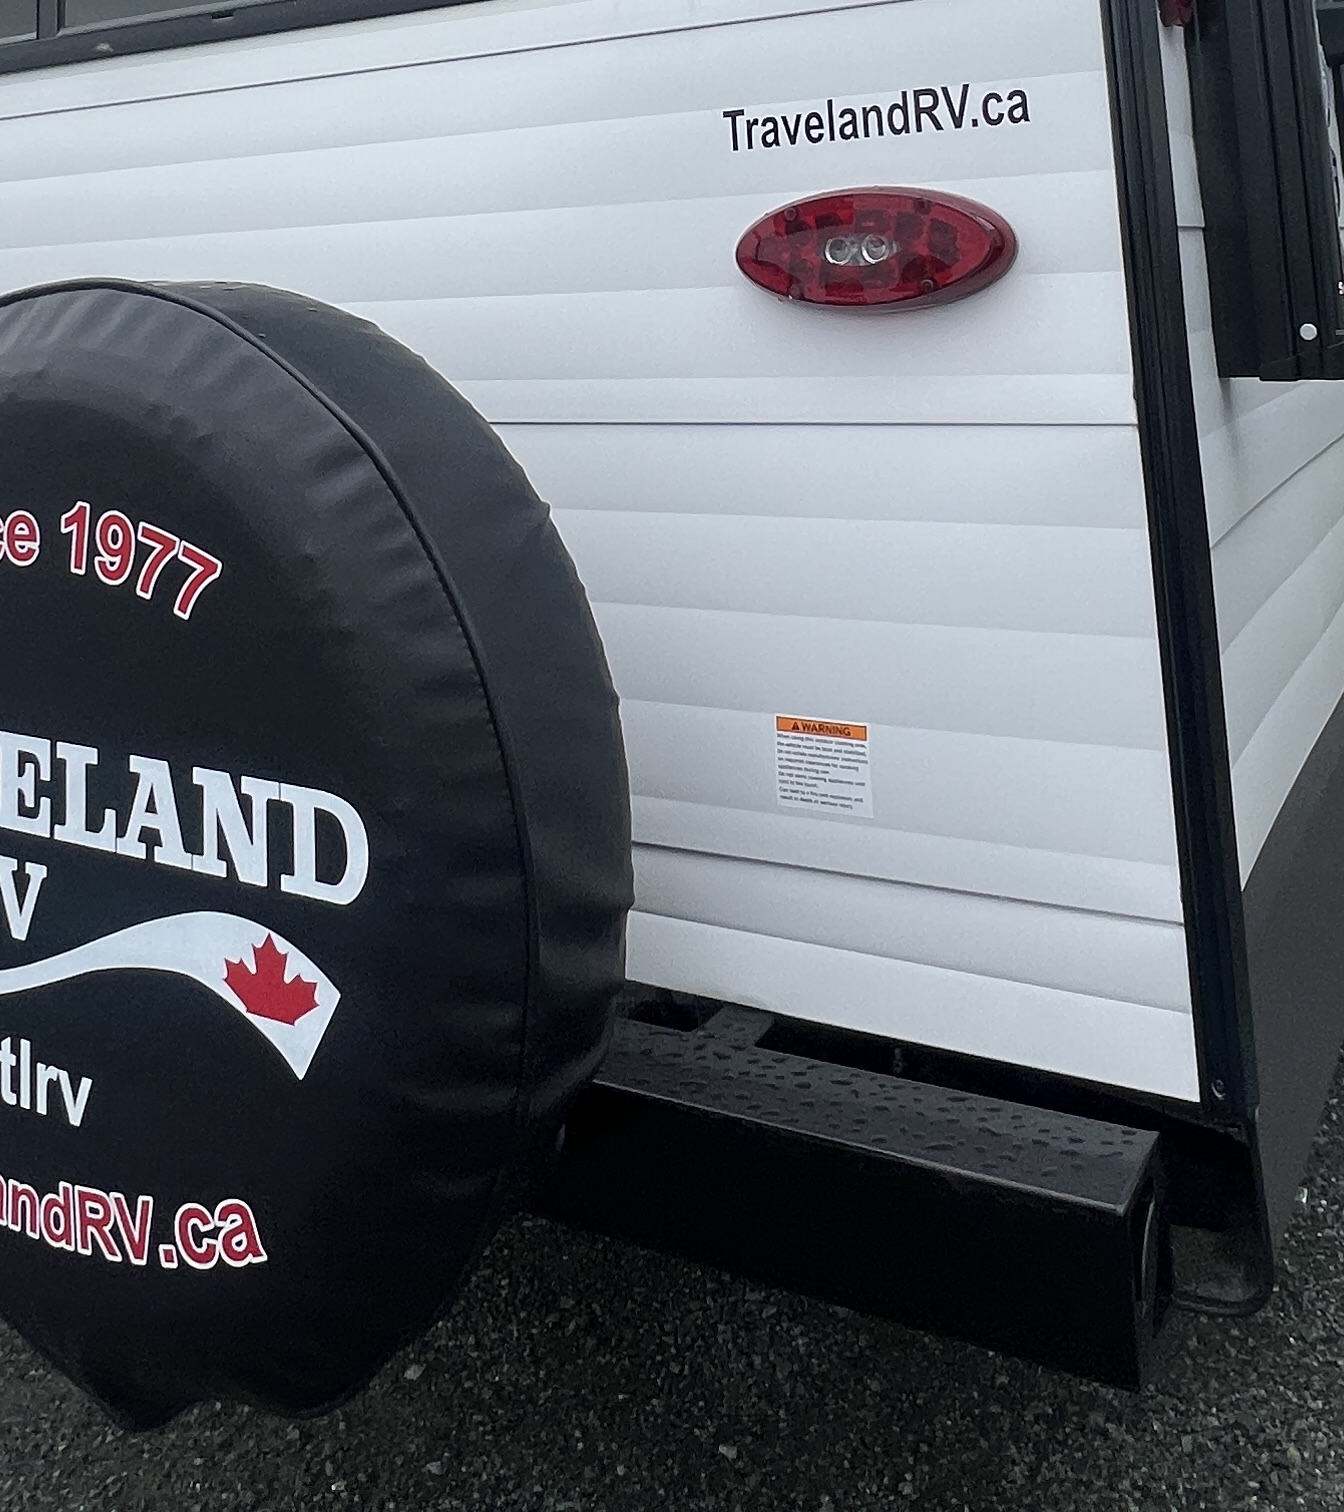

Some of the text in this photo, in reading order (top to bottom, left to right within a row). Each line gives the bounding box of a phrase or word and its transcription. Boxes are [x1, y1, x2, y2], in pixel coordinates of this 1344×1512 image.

[723, 84, 1030, 151] TravelandRV.ca
[59, 501, 222, 620] 1977
[801, 721, 851, 736] WARNING
